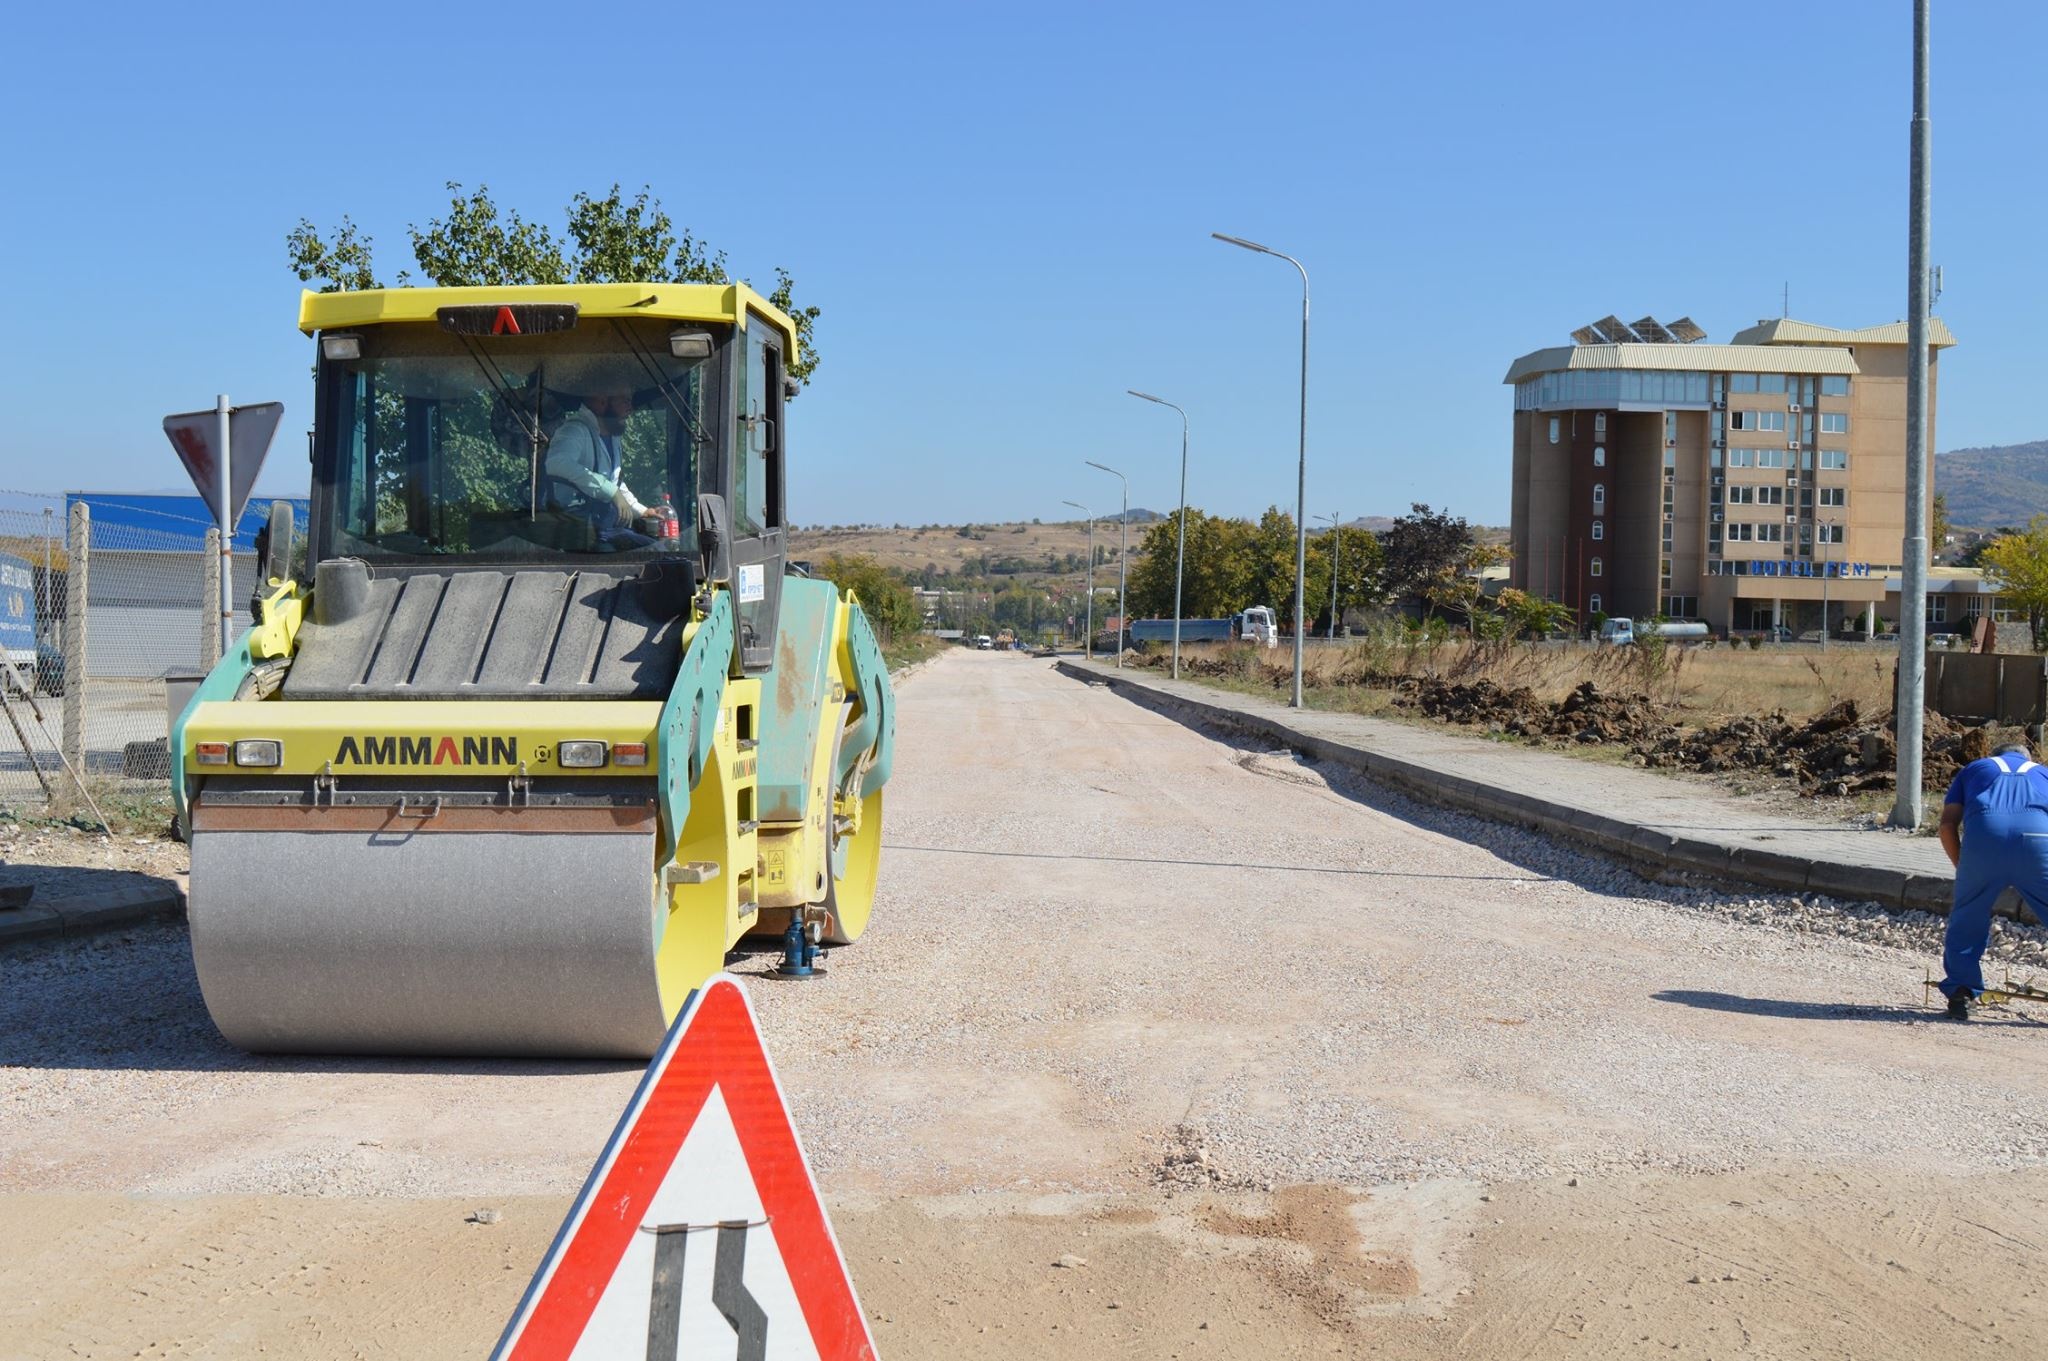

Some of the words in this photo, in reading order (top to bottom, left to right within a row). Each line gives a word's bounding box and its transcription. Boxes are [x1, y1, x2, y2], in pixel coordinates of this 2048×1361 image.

[1751, 560, 1814, 577] HOTEL
[1827, 561, 1872, 577] FENI
[334, 736, 518, 766] AMMANN
